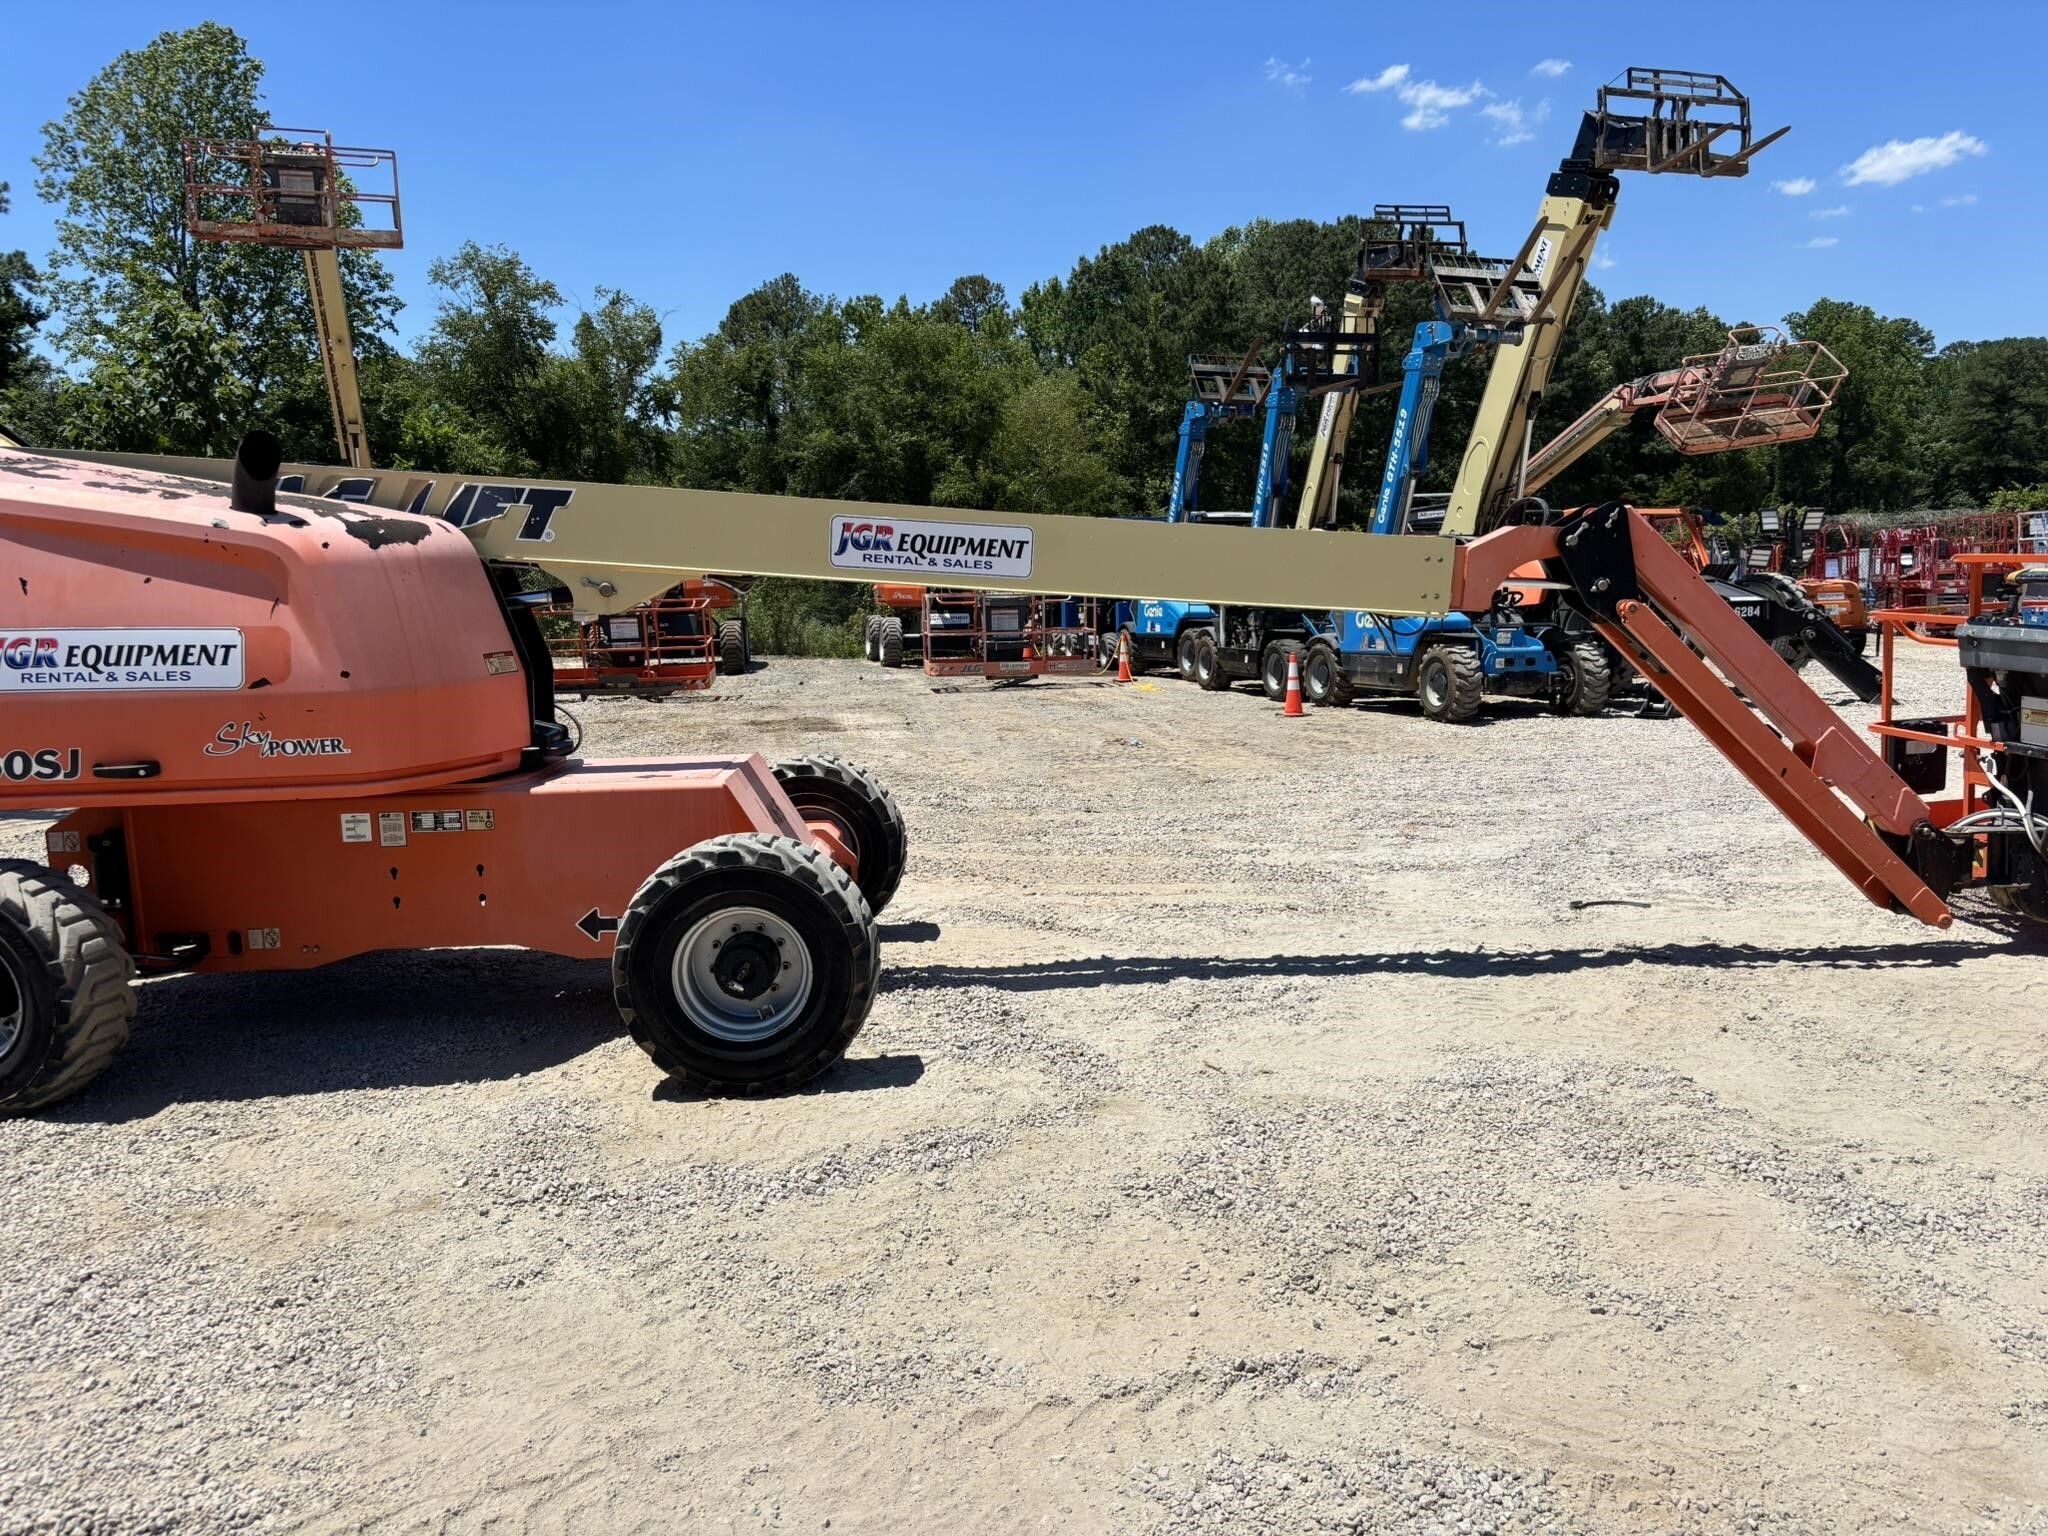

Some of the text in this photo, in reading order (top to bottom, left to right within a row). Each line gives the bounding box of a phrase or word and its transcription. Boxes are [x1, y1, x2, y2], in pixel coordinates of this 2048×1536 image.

[1386, 408, 1408, 483] GTH-5519
[834, 522, 1029, 560] JGR EQUIPMENT
[862, 553, 993, 570] RENTAL & SALES
[1144, 604, 1163, 618] Genie
[64, 643, 238, 675] EQUIPMENT
[21, 670, 192, 684] RENTAL & SALES
[0, 747, 81, 781] 0SJ
